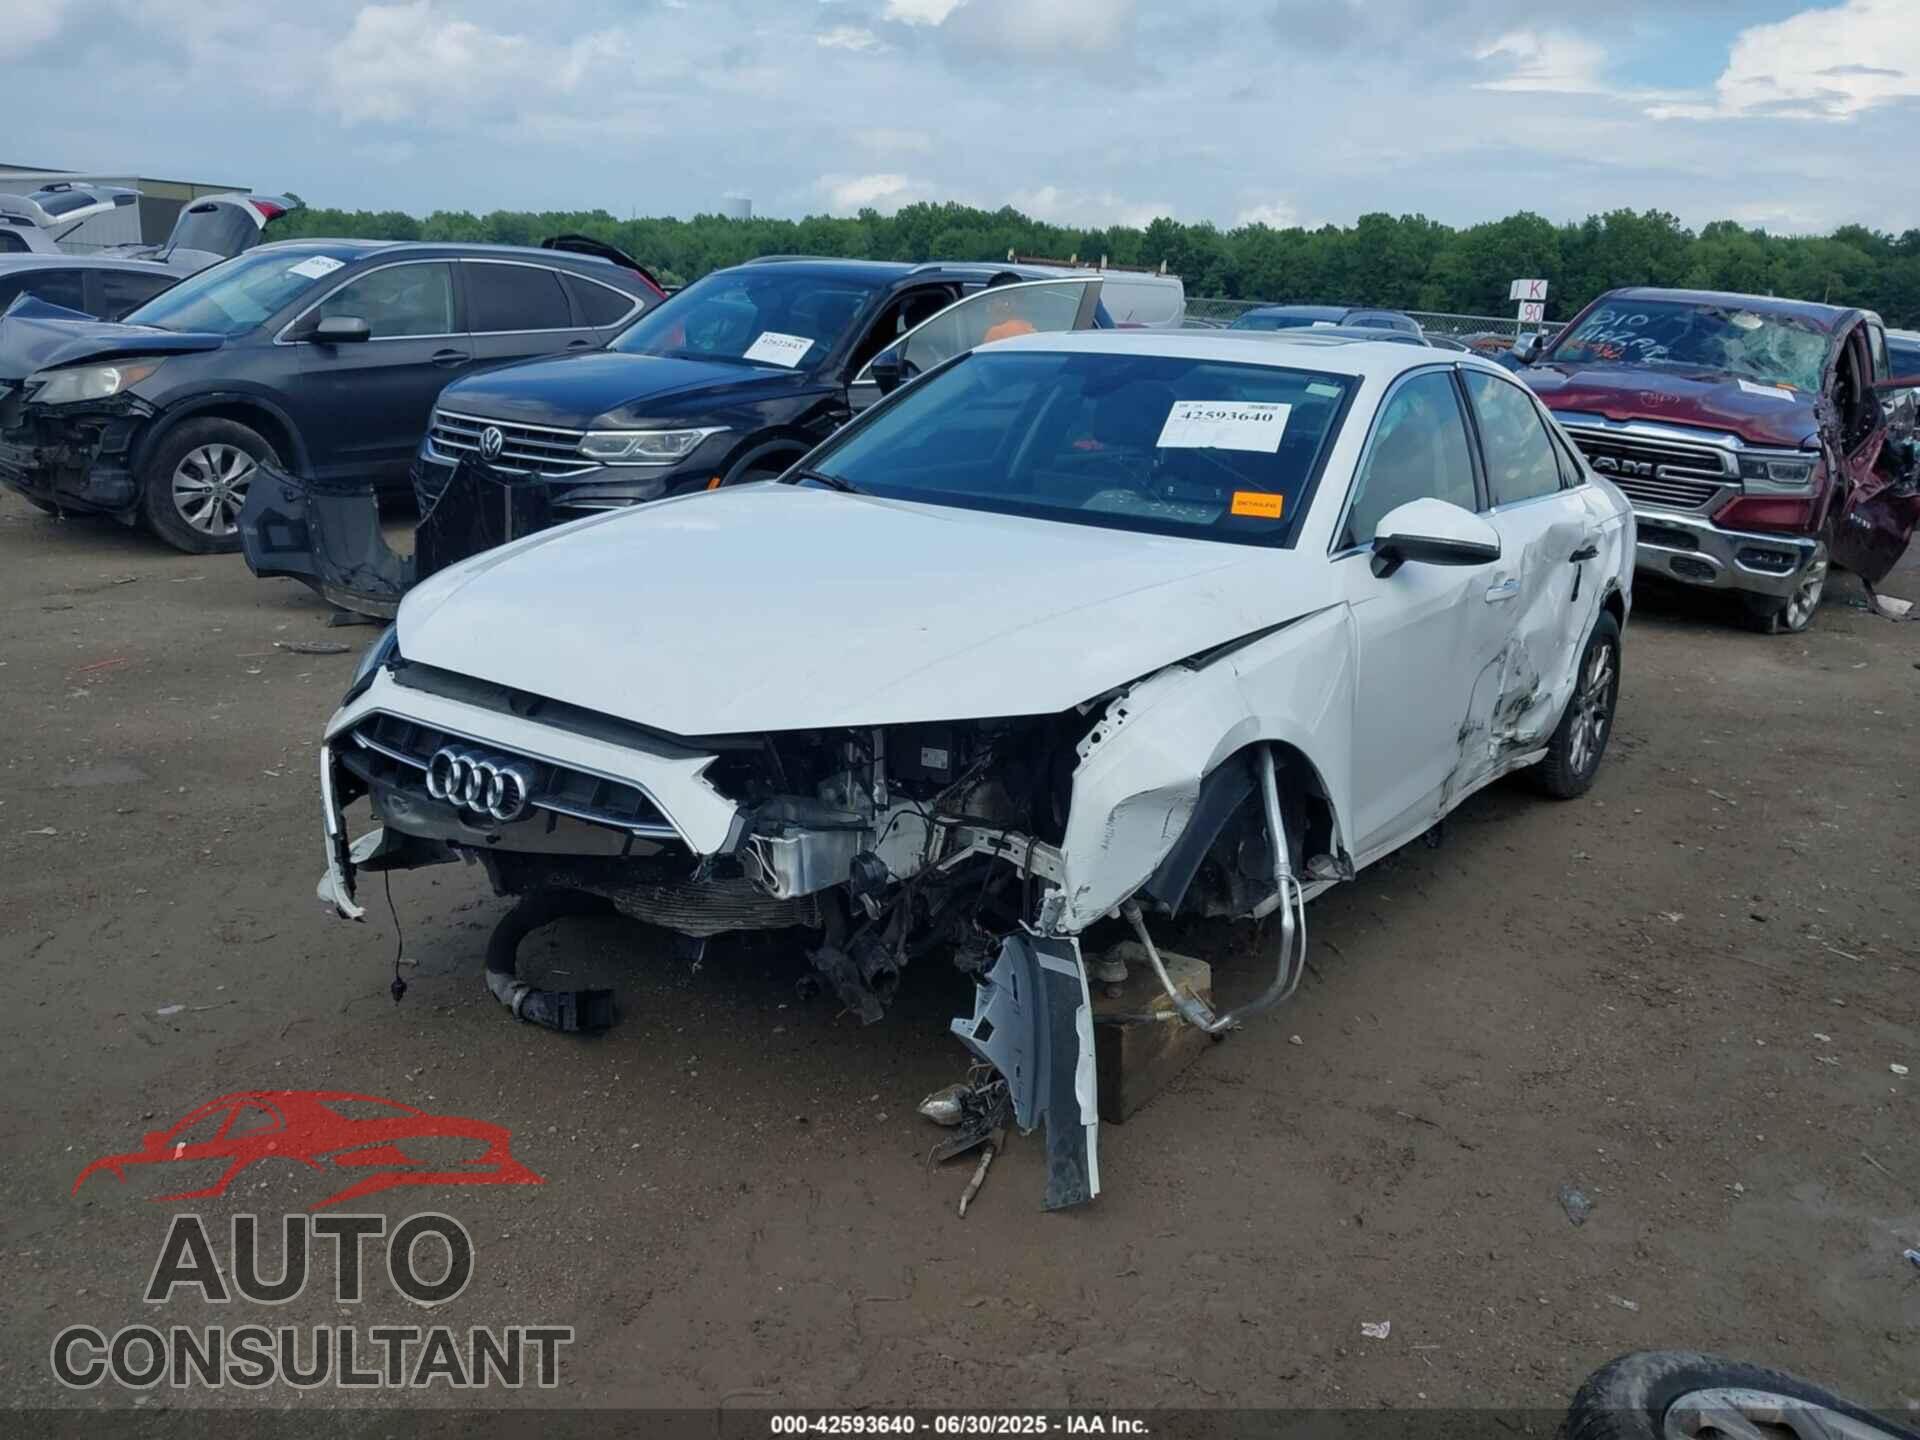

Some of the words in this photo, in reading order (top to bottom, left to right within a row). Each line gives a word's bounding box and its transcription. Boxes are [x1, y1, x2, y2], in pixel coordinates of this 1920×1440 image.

[1530, 280, 1543, 298] K
[1525, 304, 1542, 321] 90
[1181, 410, 1273, 421] 42593640
